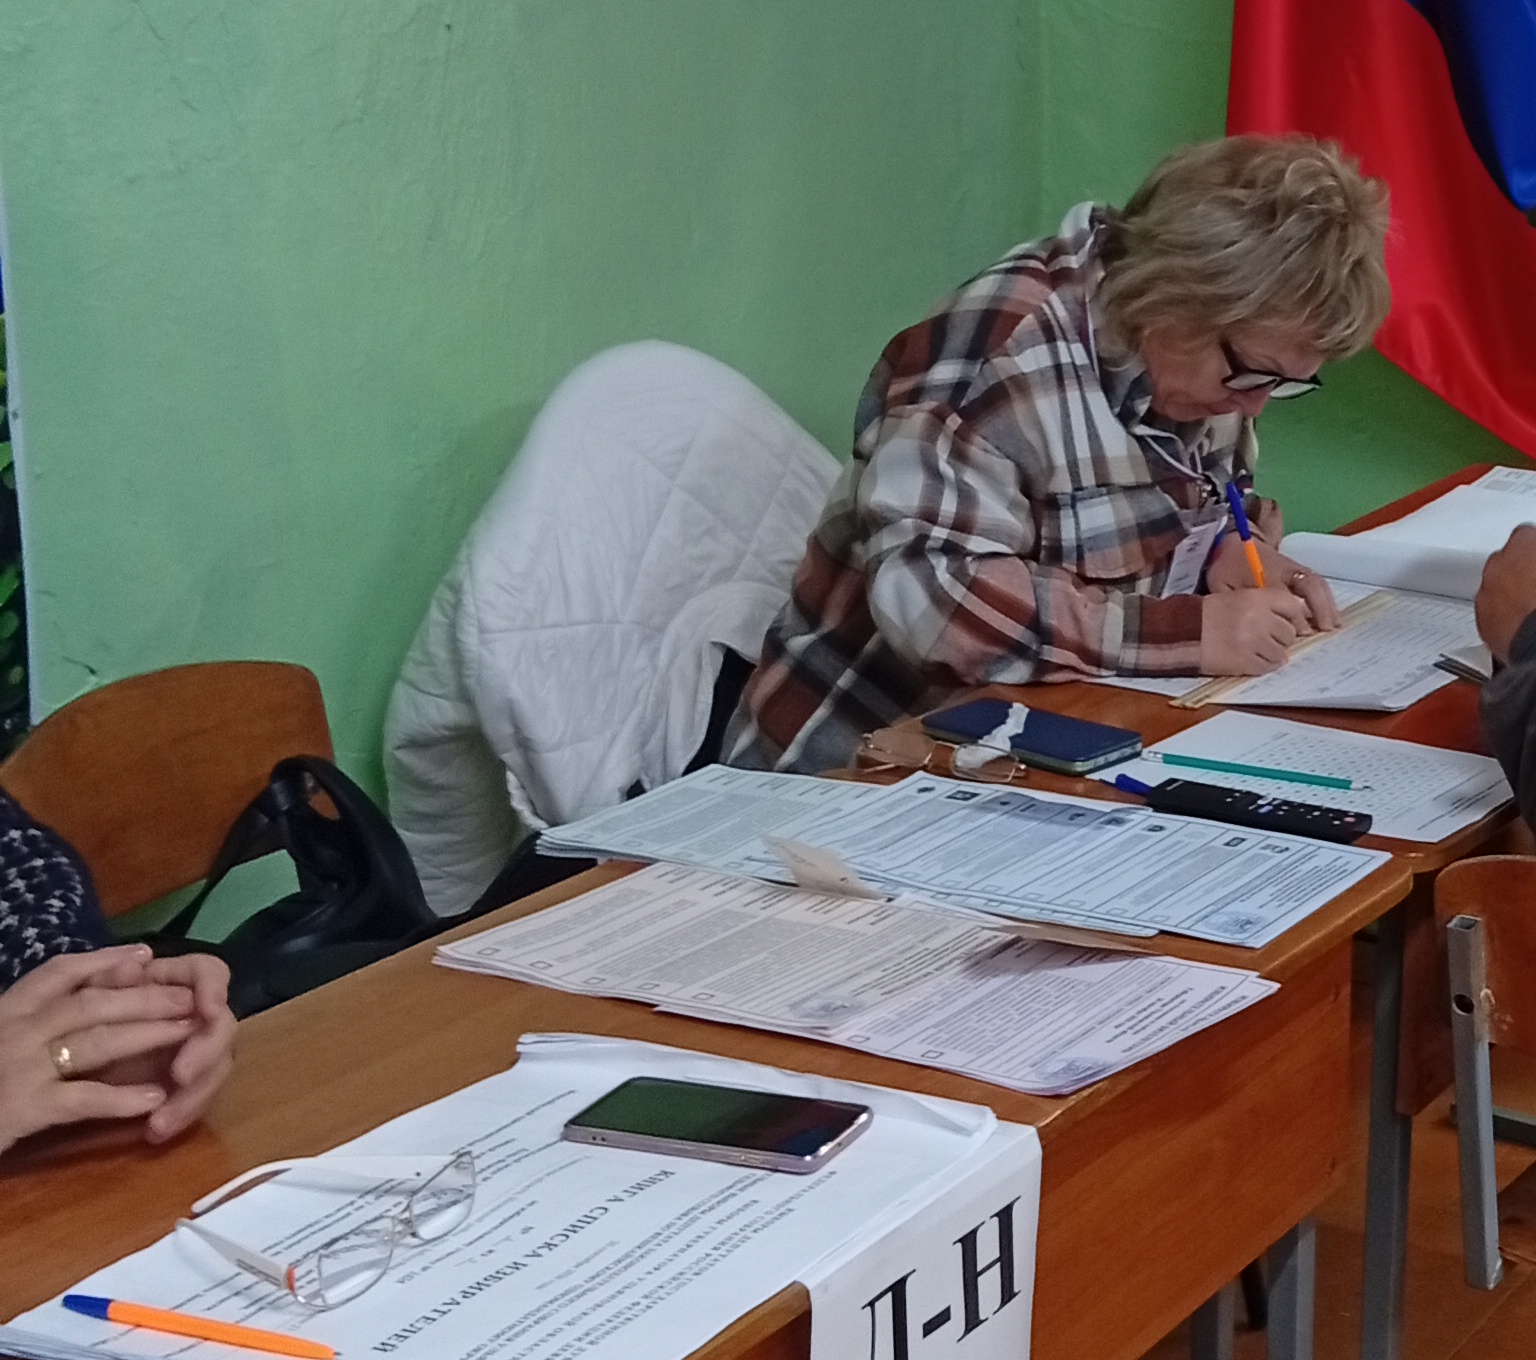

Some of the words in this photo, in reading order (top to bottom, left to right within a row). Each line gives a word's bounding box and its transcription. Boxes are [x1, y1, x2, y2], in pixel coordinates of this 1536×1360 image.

[603, 1168, 677, 1205] КНИГА
[521, 1204, 613, 1261] СПИСКА
[642, 1224, 720, 1276] ГУБЕРНАТОРА
[689, 1234, 755, 1277] ДЕПУТАТОВ
[561, 1275, 648, 1327] УЛЬЯНОВСКОЙ
[639, 1251, 714, 1300] РОССИЙСКОЙ
[367, 1259, 530, 1355] ИЗБИРАТЕЛЕЙ
[583, 1276, 695, 1346] ГОСУДАРСТВЕННОЙ
